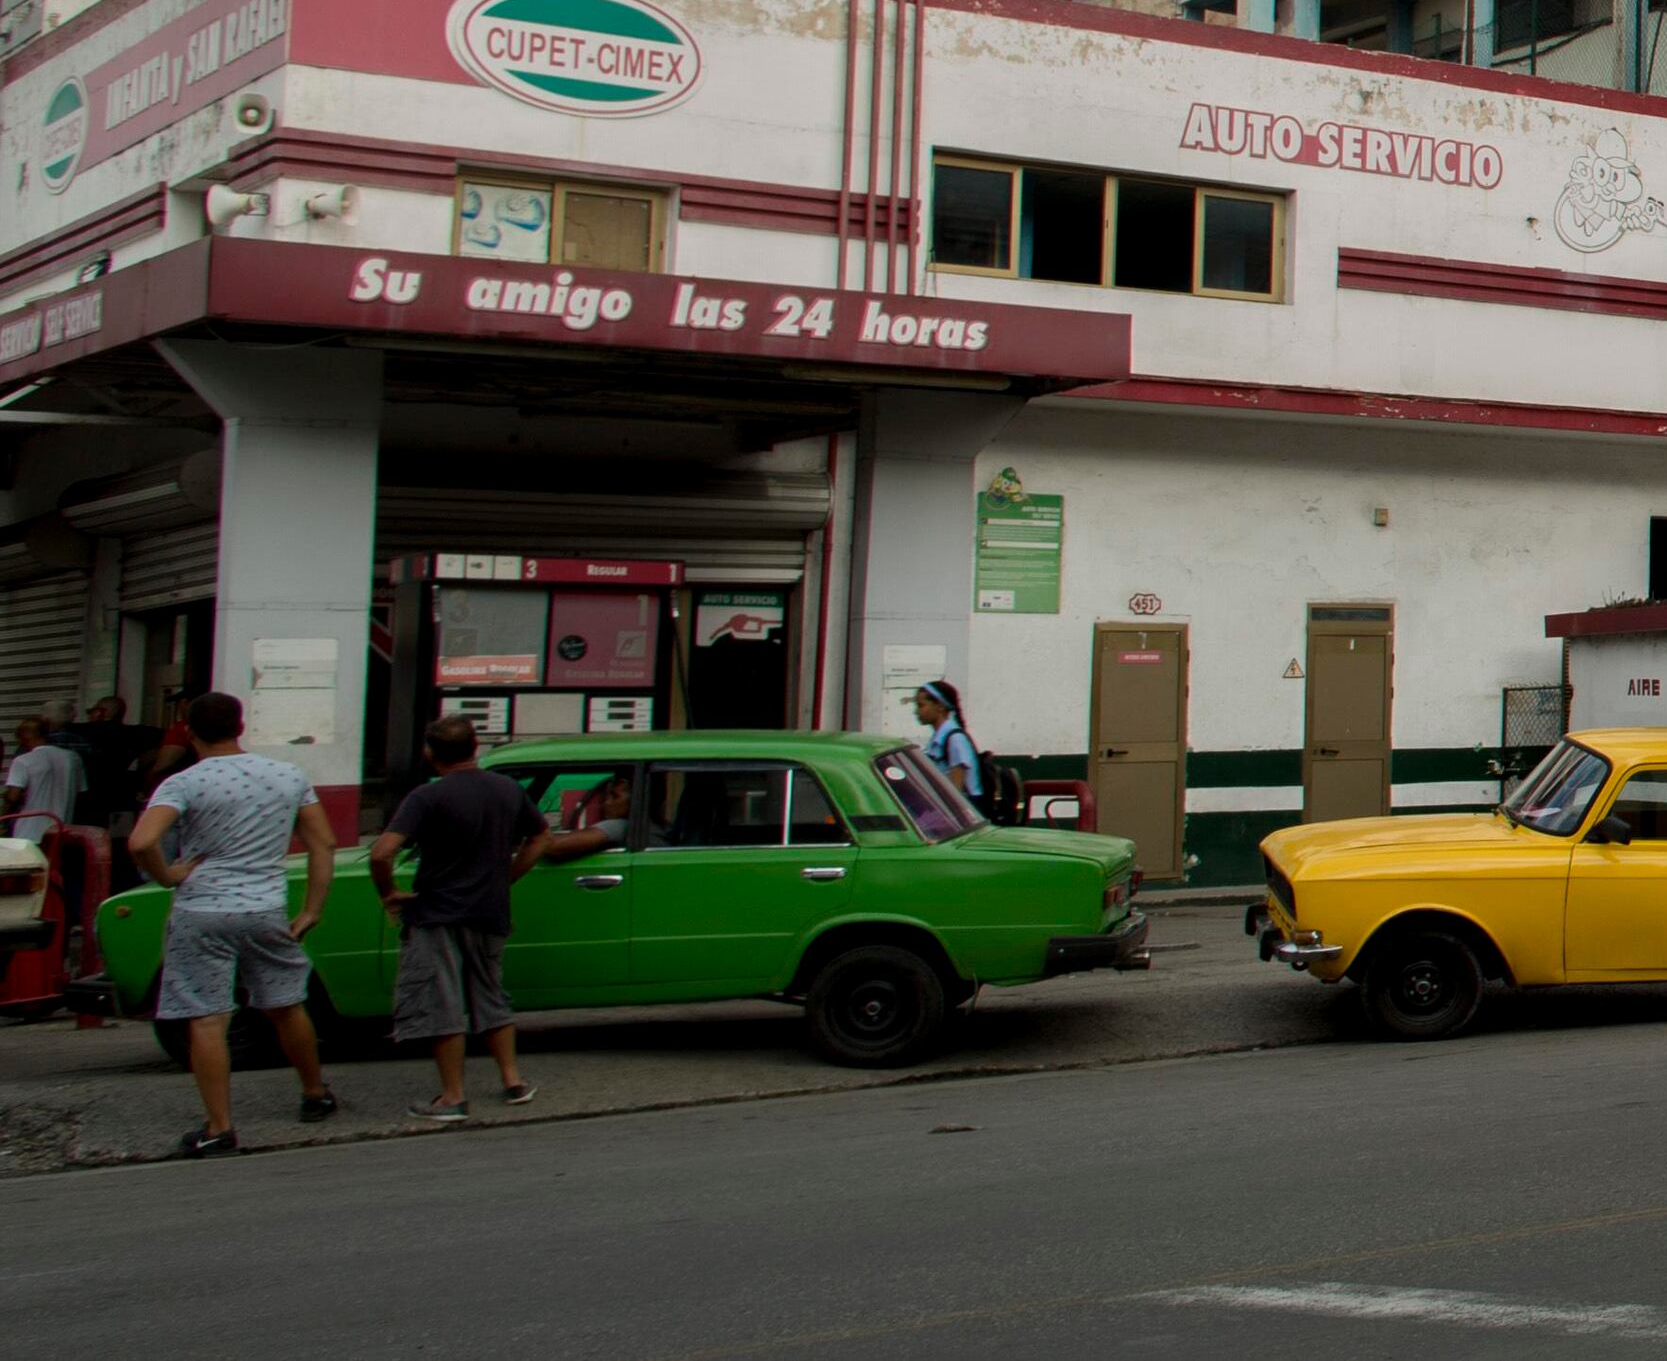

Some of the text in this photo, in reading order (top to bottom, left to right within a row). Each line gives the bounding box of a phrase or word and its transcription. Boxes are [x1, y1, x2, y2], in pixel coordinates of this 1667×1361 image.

[106, 51, 169, 131] INFANTA
[172, 55, 184, 107] y
[186, 19, 222, 86] SAN
[486, 26, 685, 85] CUPET-CIMEX
[1180, 103, 1503, 189] AUTO SERVICIO
[350, 257, 990, 352] Su amigo las 24 horas
[525, 559, 537, 578] 3
[668, 564, 677, 582] 1
[702, 593, 778, 605] AUTO SERVICIO
[1134, 596, 1154, 611] 451
[1627, 678, 1661, 697] AIRE
